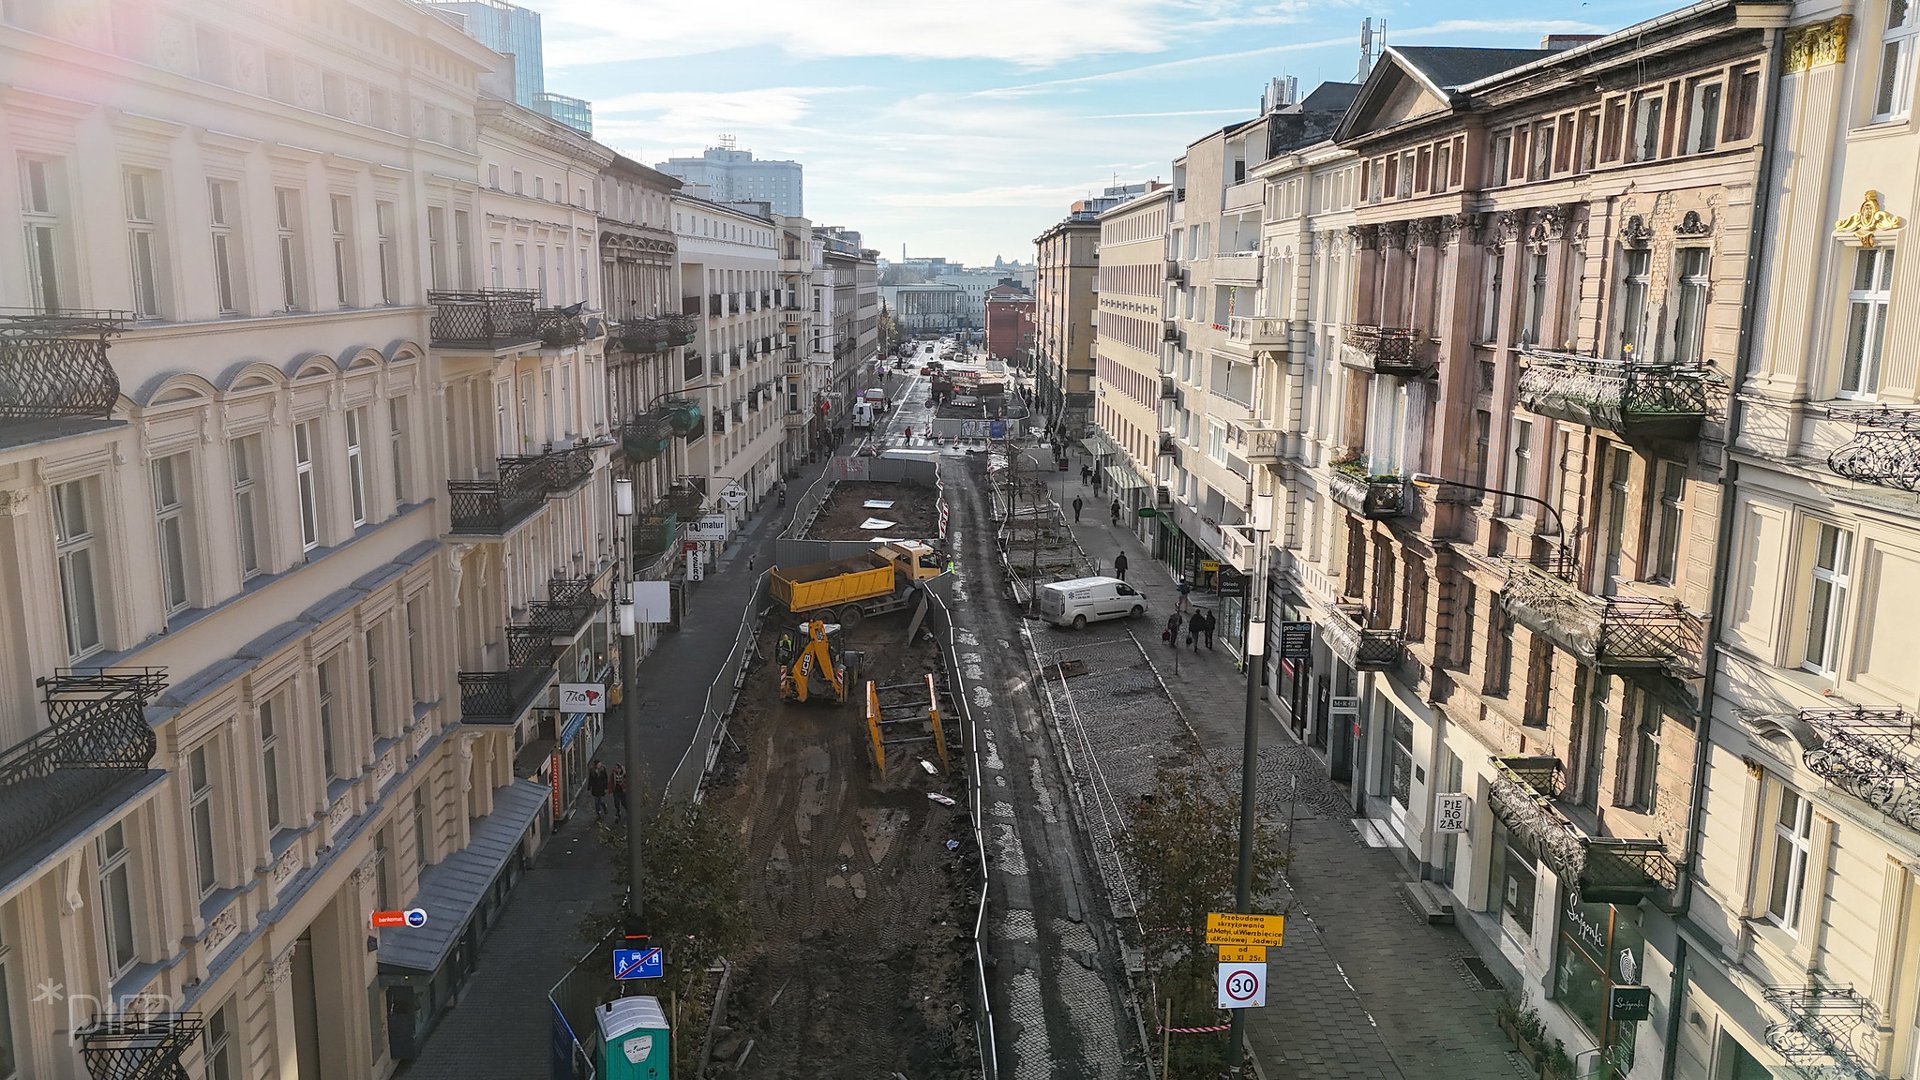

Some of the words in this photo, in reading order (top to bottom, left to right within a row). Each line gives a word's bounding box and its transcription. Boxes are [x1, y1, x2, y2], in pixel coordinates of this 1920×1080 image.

[692, 551, 700, 580] KSERO
[802, 653, 811, 676] JCB
[1220, 914, 1265, 922] Przebudowa
[1252, 937, 1281, 946] Jadwigi
[1231, 978, 1254, 993] 30
